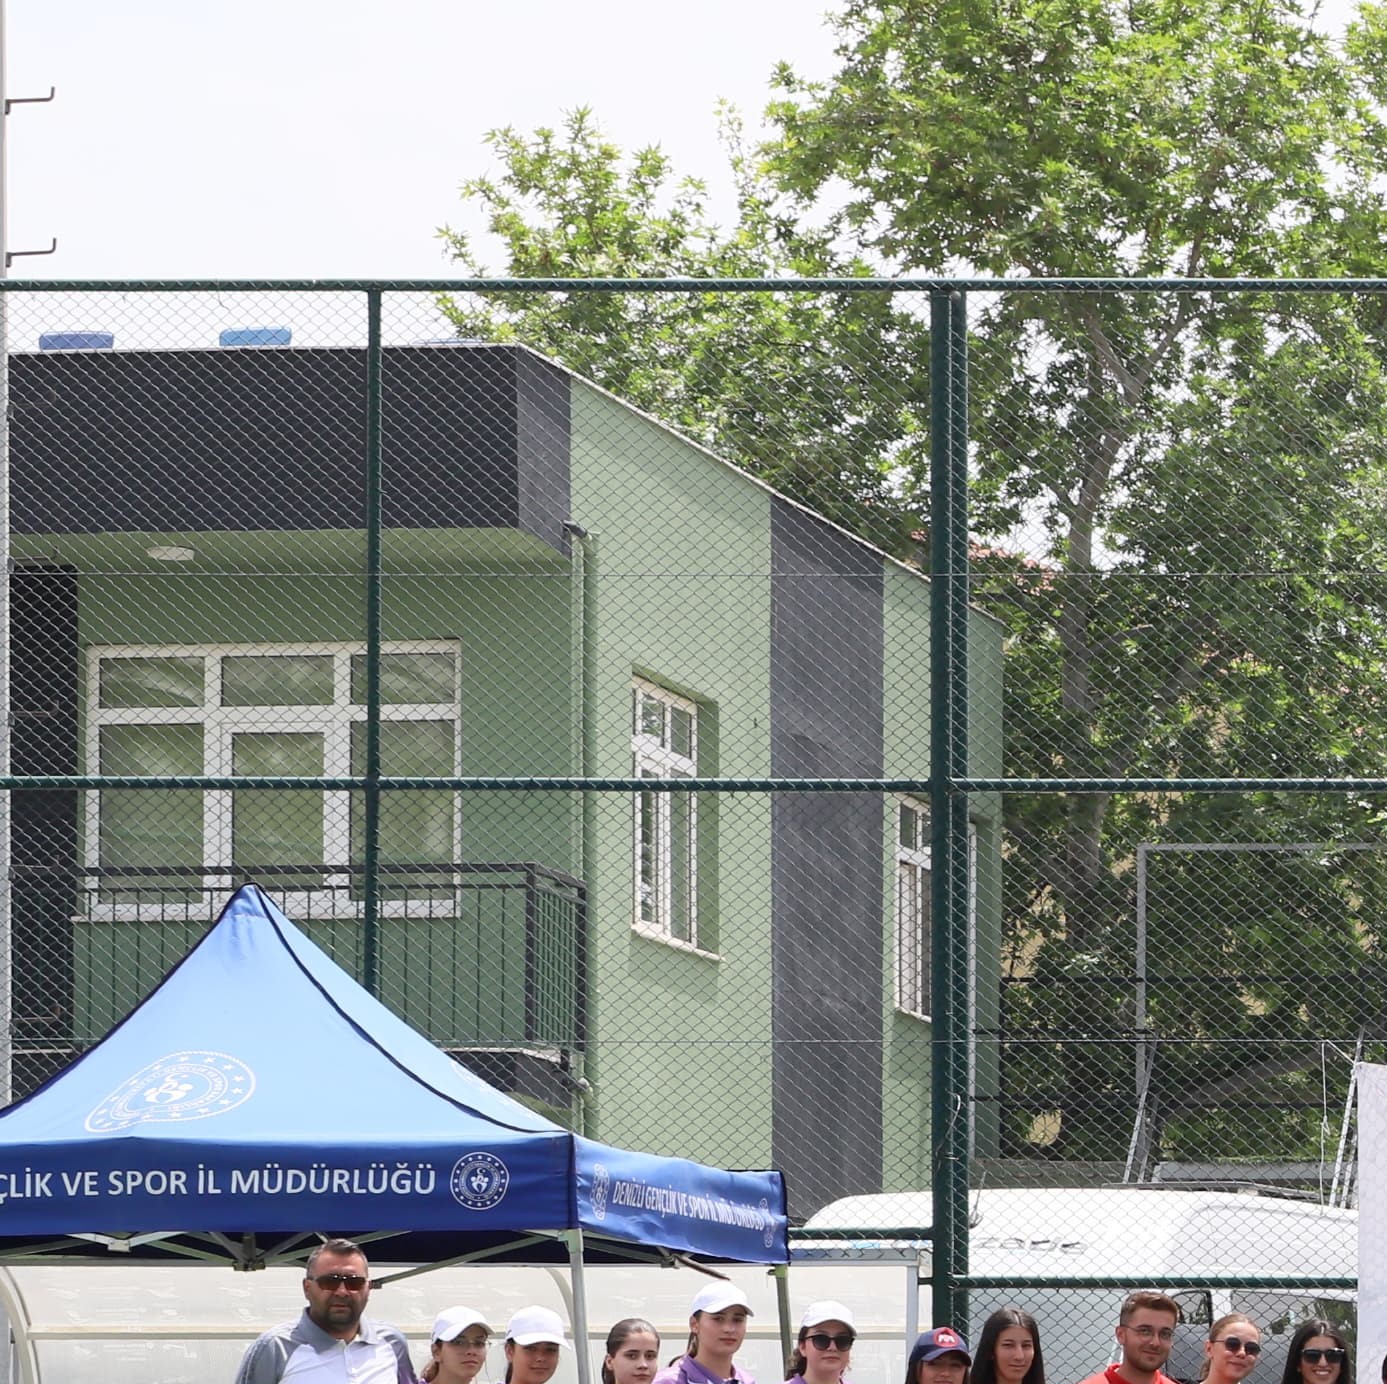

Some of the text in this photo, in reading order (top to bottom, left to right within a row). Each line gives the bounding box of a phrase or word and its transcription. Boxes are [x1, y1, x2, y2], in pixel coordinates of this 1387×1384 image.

[61, 1171, 99, 1196] VE
[107, 1170, 188, 1196] SPOR
[198, 1163, 221, 1194] İL
[231, 1162, 436, 1195] MÜDÜRLÜĞÜ
[612, 1177, 646, 1206] DENİZLİ
[645, 1185, 678, 1217] GENÇLİK
[678, 1194, 690, 1216] VE
[689, 1195, 709, 1221] SPOR
